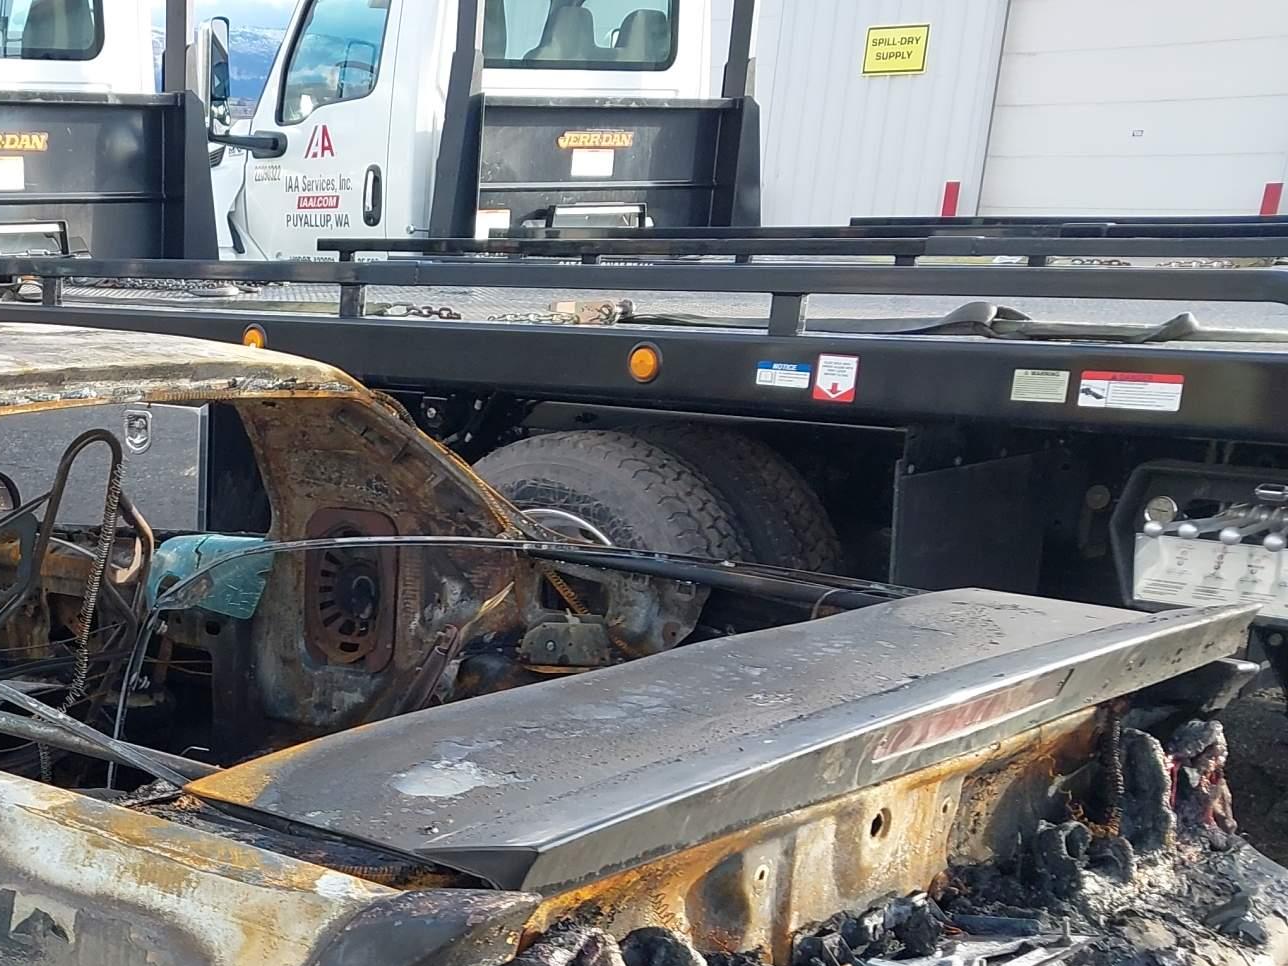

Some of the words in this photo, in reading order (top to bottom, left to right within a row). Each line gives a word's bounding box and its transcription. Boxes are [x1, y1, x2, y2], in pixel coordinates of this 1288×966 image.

[872, 36, 921, 47] SPILL-DRY
[875, 51, 913, 61] SUPPLY
[285, 176, 299, 192] IAA
[302, 174, 337, 192] Services,
[339, 173, 353, 191] Inc.
[298, 197, 337, 208] IAAI.COM
[286, 214, 333, 229] PUYALLUP,
[335, 214, 350, 227] WA
